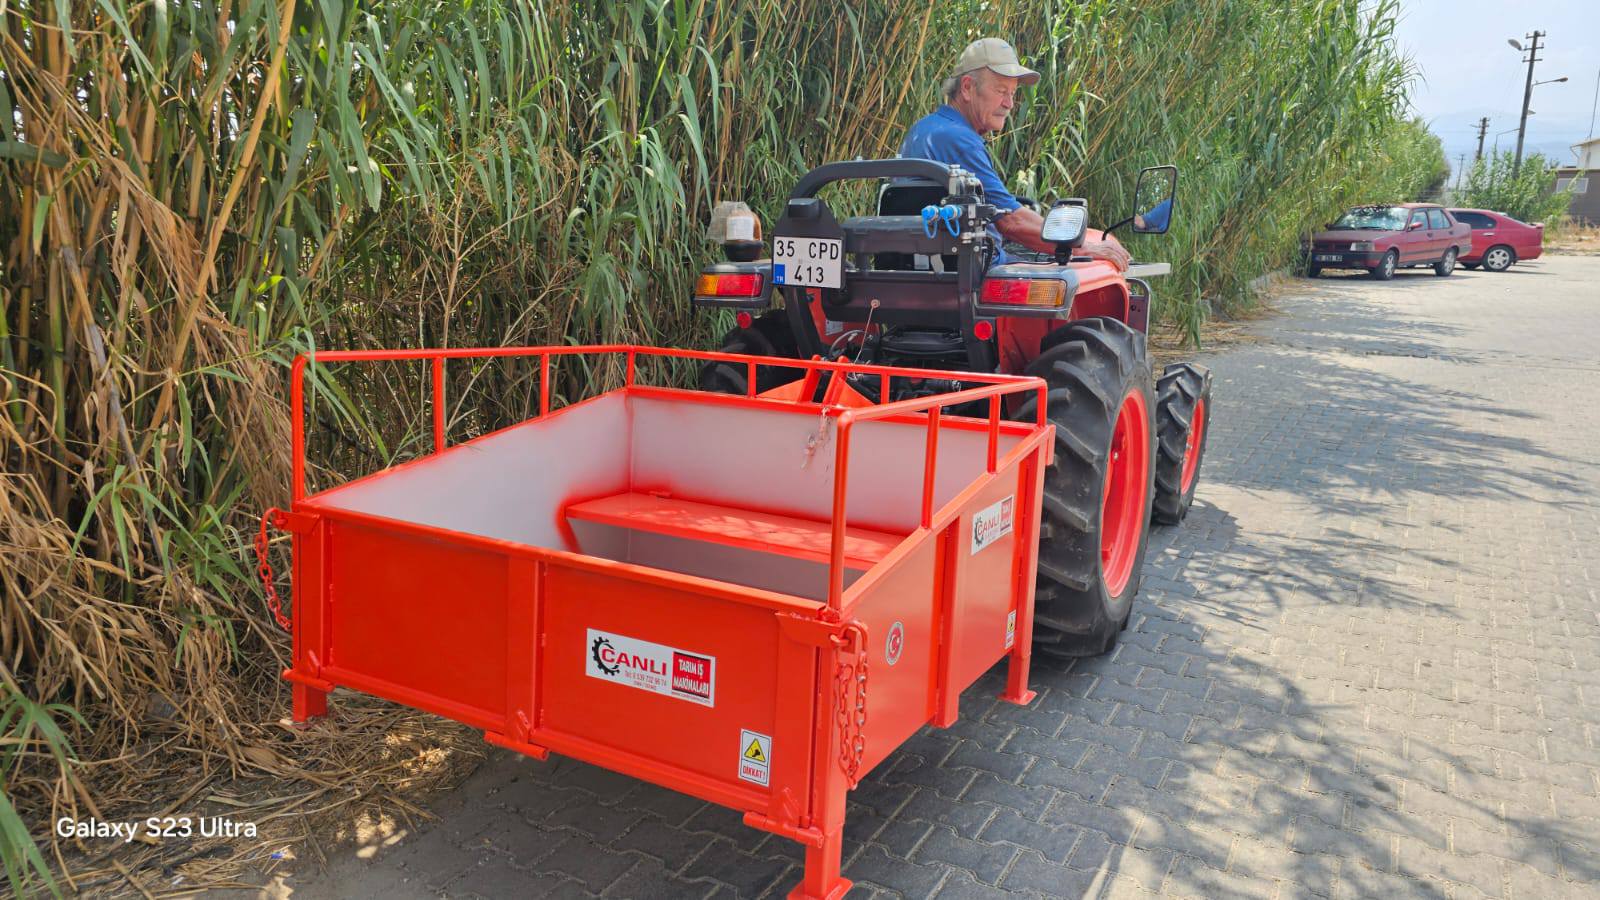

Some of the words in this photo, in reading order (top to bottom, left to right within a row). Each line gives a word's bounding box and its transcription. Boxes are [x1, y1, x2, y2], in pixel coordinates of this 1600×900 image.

[776, 240, 795, 257] 35
[808, 242, 839, 260] CPD
[794, 265, 824, 283] 413
[977, 513, 1000, 536] CANLI
[601, 648, 667, 676] CANLI
[678, 658, 697, 675] TARIM
